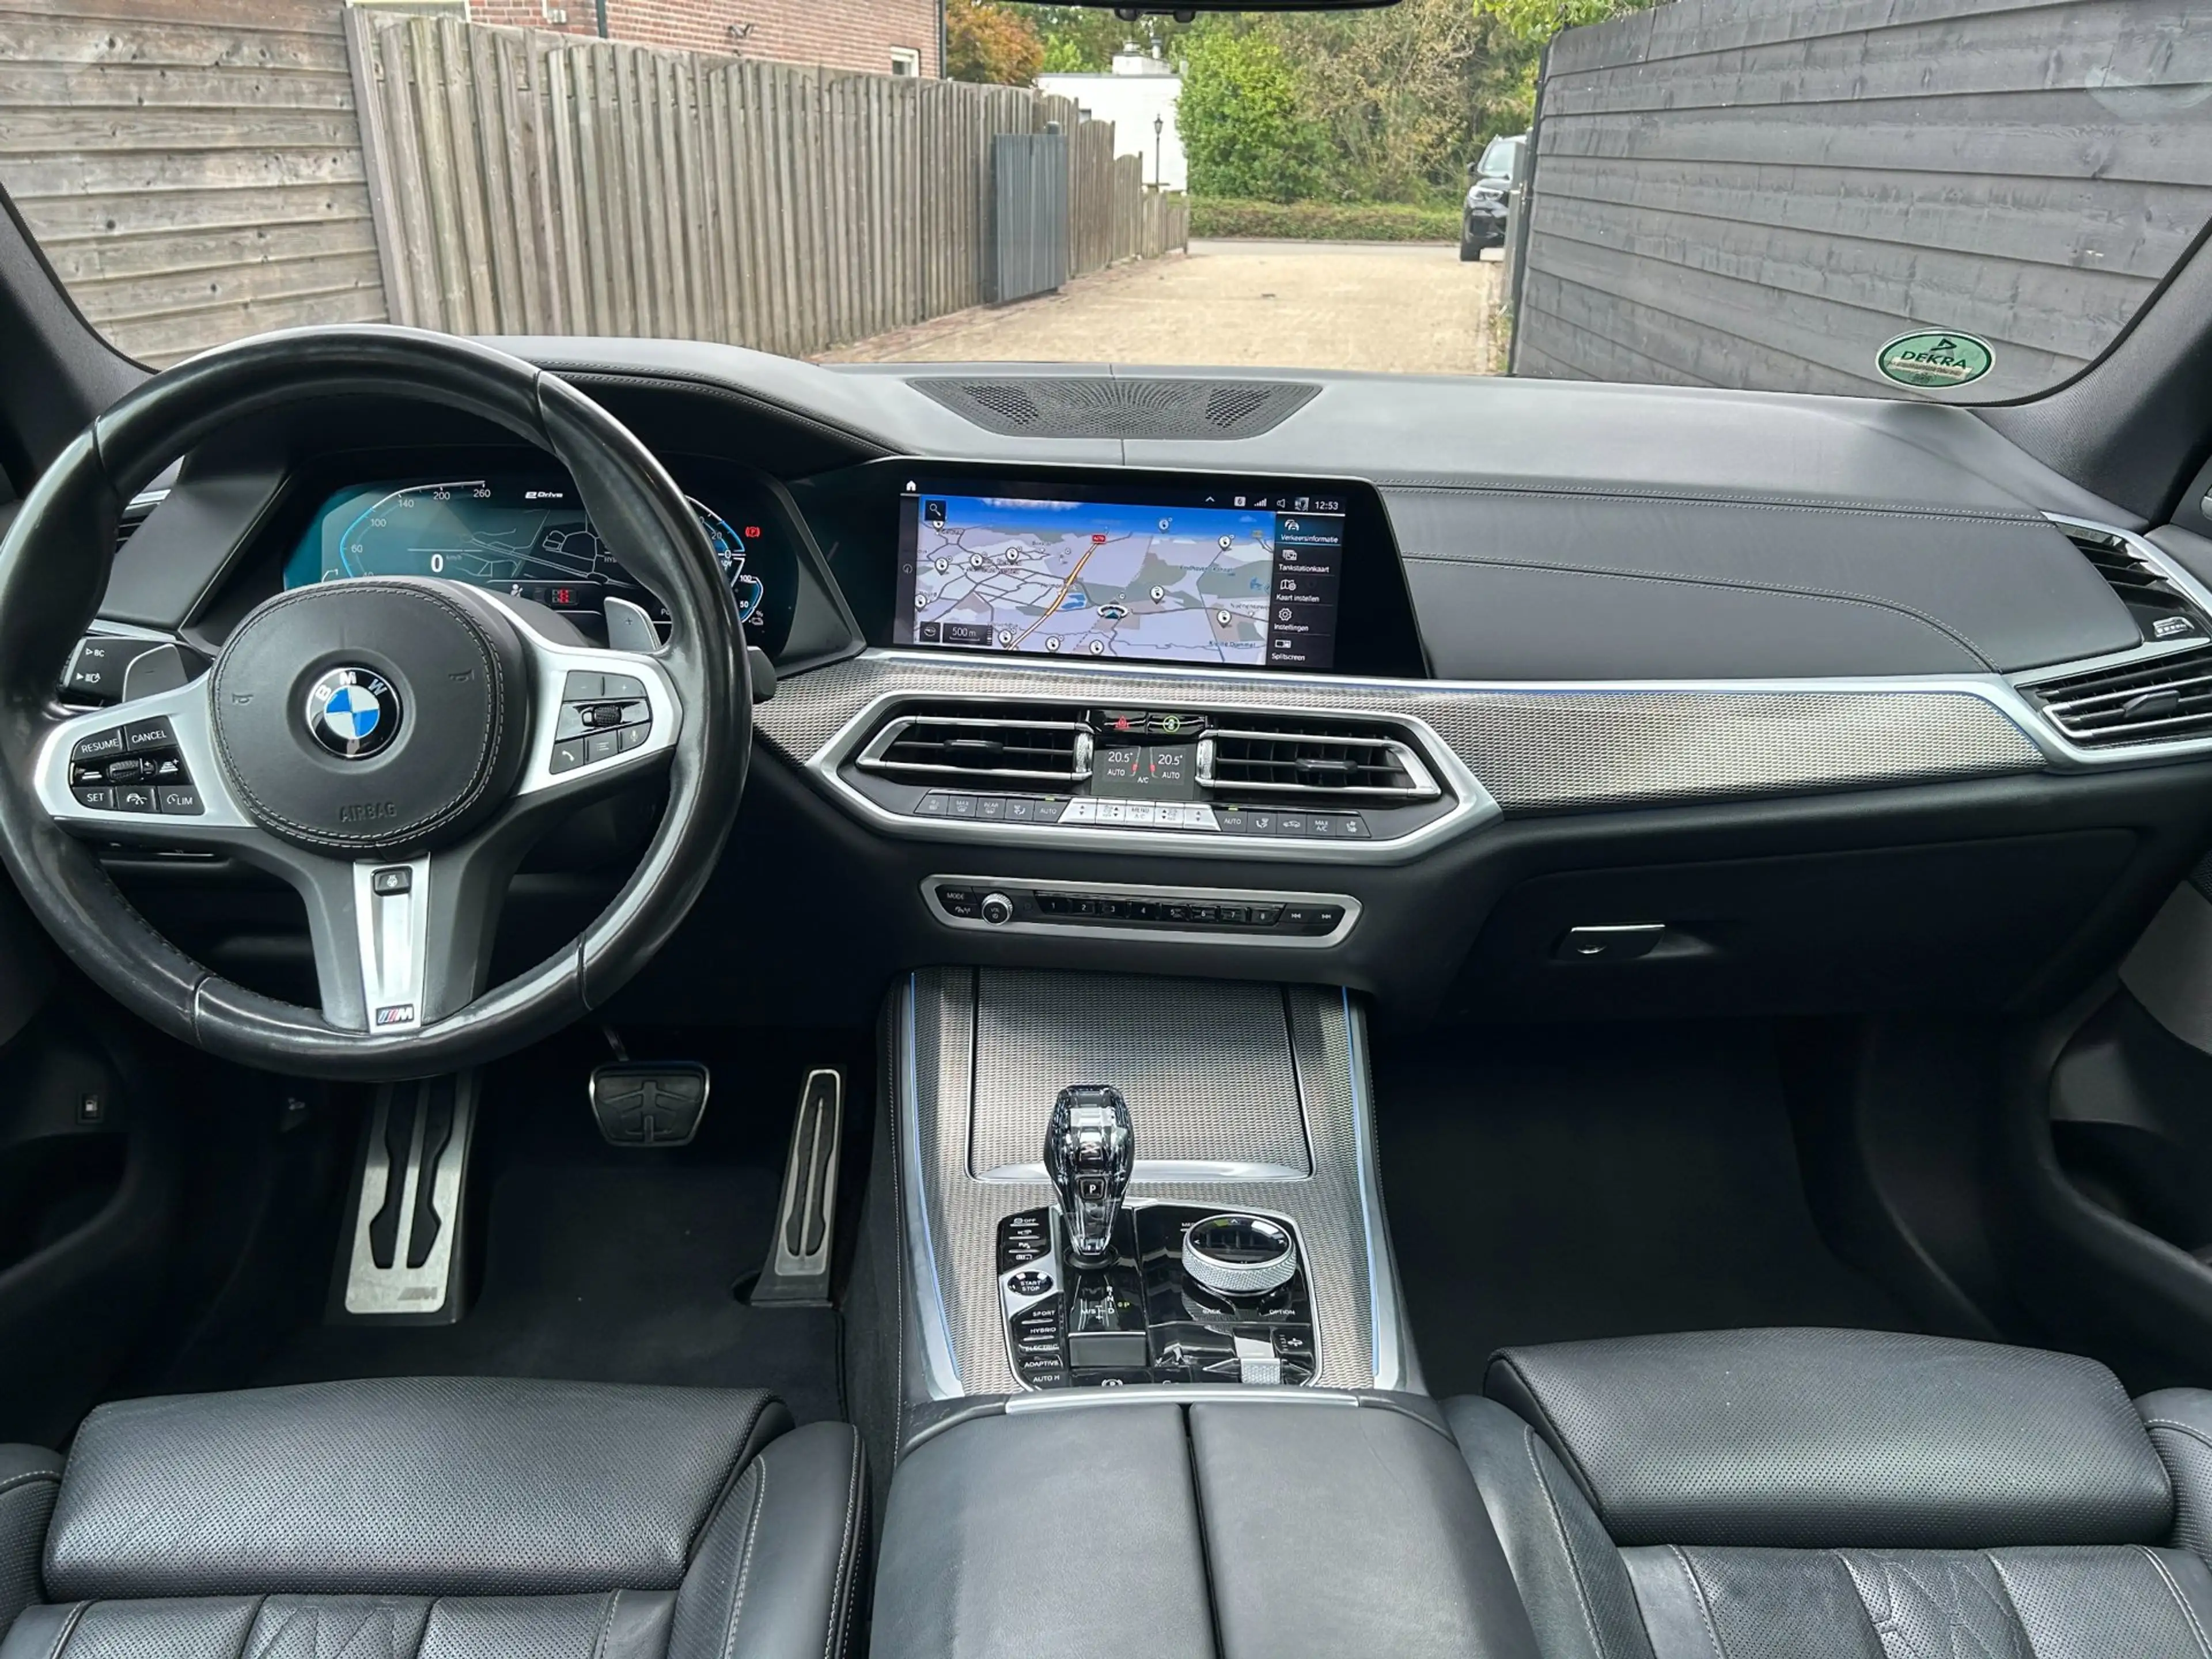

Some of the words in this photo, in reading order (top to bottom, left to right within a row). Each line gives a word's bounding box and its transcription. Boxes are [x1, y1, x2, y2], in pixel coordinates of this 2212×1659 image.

[1901, 351, 1966, 369] DEKRA
[433, 491, 450, 500] 200
[474, 489, 491, 498] 260
[399, 499, 414, 507] 140
[1315, 501, 1338, 510] 12:53
[371, 518, 387, 527] 100
[711, 532, 722, 540] 20
[1281, 534, 1339, 543] Verkeersinformatie
[351, 545, 363, 553] 60
[431, 554, 444, 573] 0
[1279, 563, 1330, 573] Tankstationkaart
[952, 627, 967, 637] 500
[1274, 623, 1309, 632] Instellingen
[94, 649, 105, 657] BC
[1272, 652, 1305, 661] Splitscreen
[315, 671, 387, 702] BMW
[131, 730, 167, 743] CANCEL
[82, 738, 119, 753] RESUME
[1107, 768, 1125, 777] AUTO
[88, 793, 104, 802] SET
[177, 797, 192, 805] LIM
[339, 802, 397, 822] AIRBAG
[1089, 1184, 1096, 1193] P
